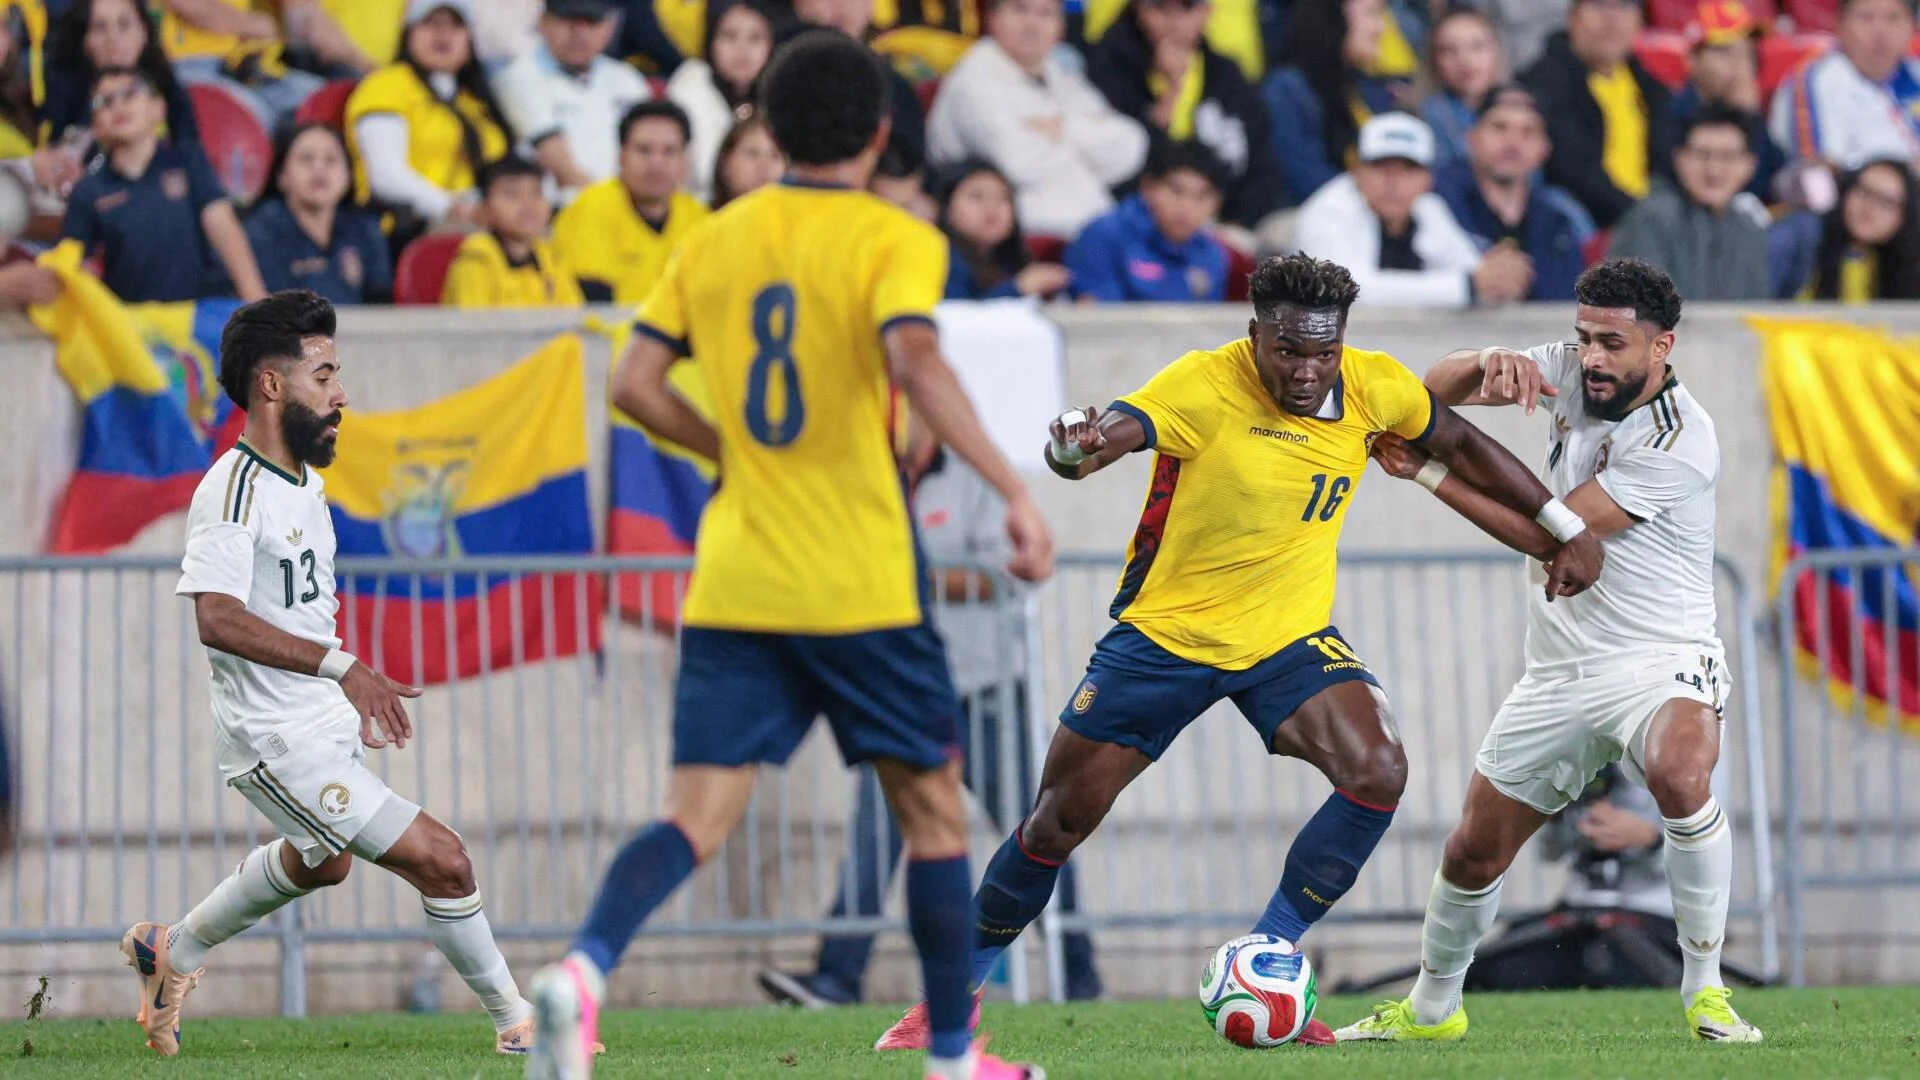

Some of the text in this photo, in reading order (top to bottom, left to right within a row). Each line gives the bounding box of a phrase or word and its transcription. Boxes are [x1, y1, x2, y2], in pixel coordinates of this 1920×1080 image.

[743, 280, 805, 447] 8
[1249, 426, 1309, 444] marathon
[1301, 473, 1351, 522] 16
[279, 548, 319, 609] 13
[1675, 672, 1704, 693] 4
[1302, 886, 1336, 906] mara
